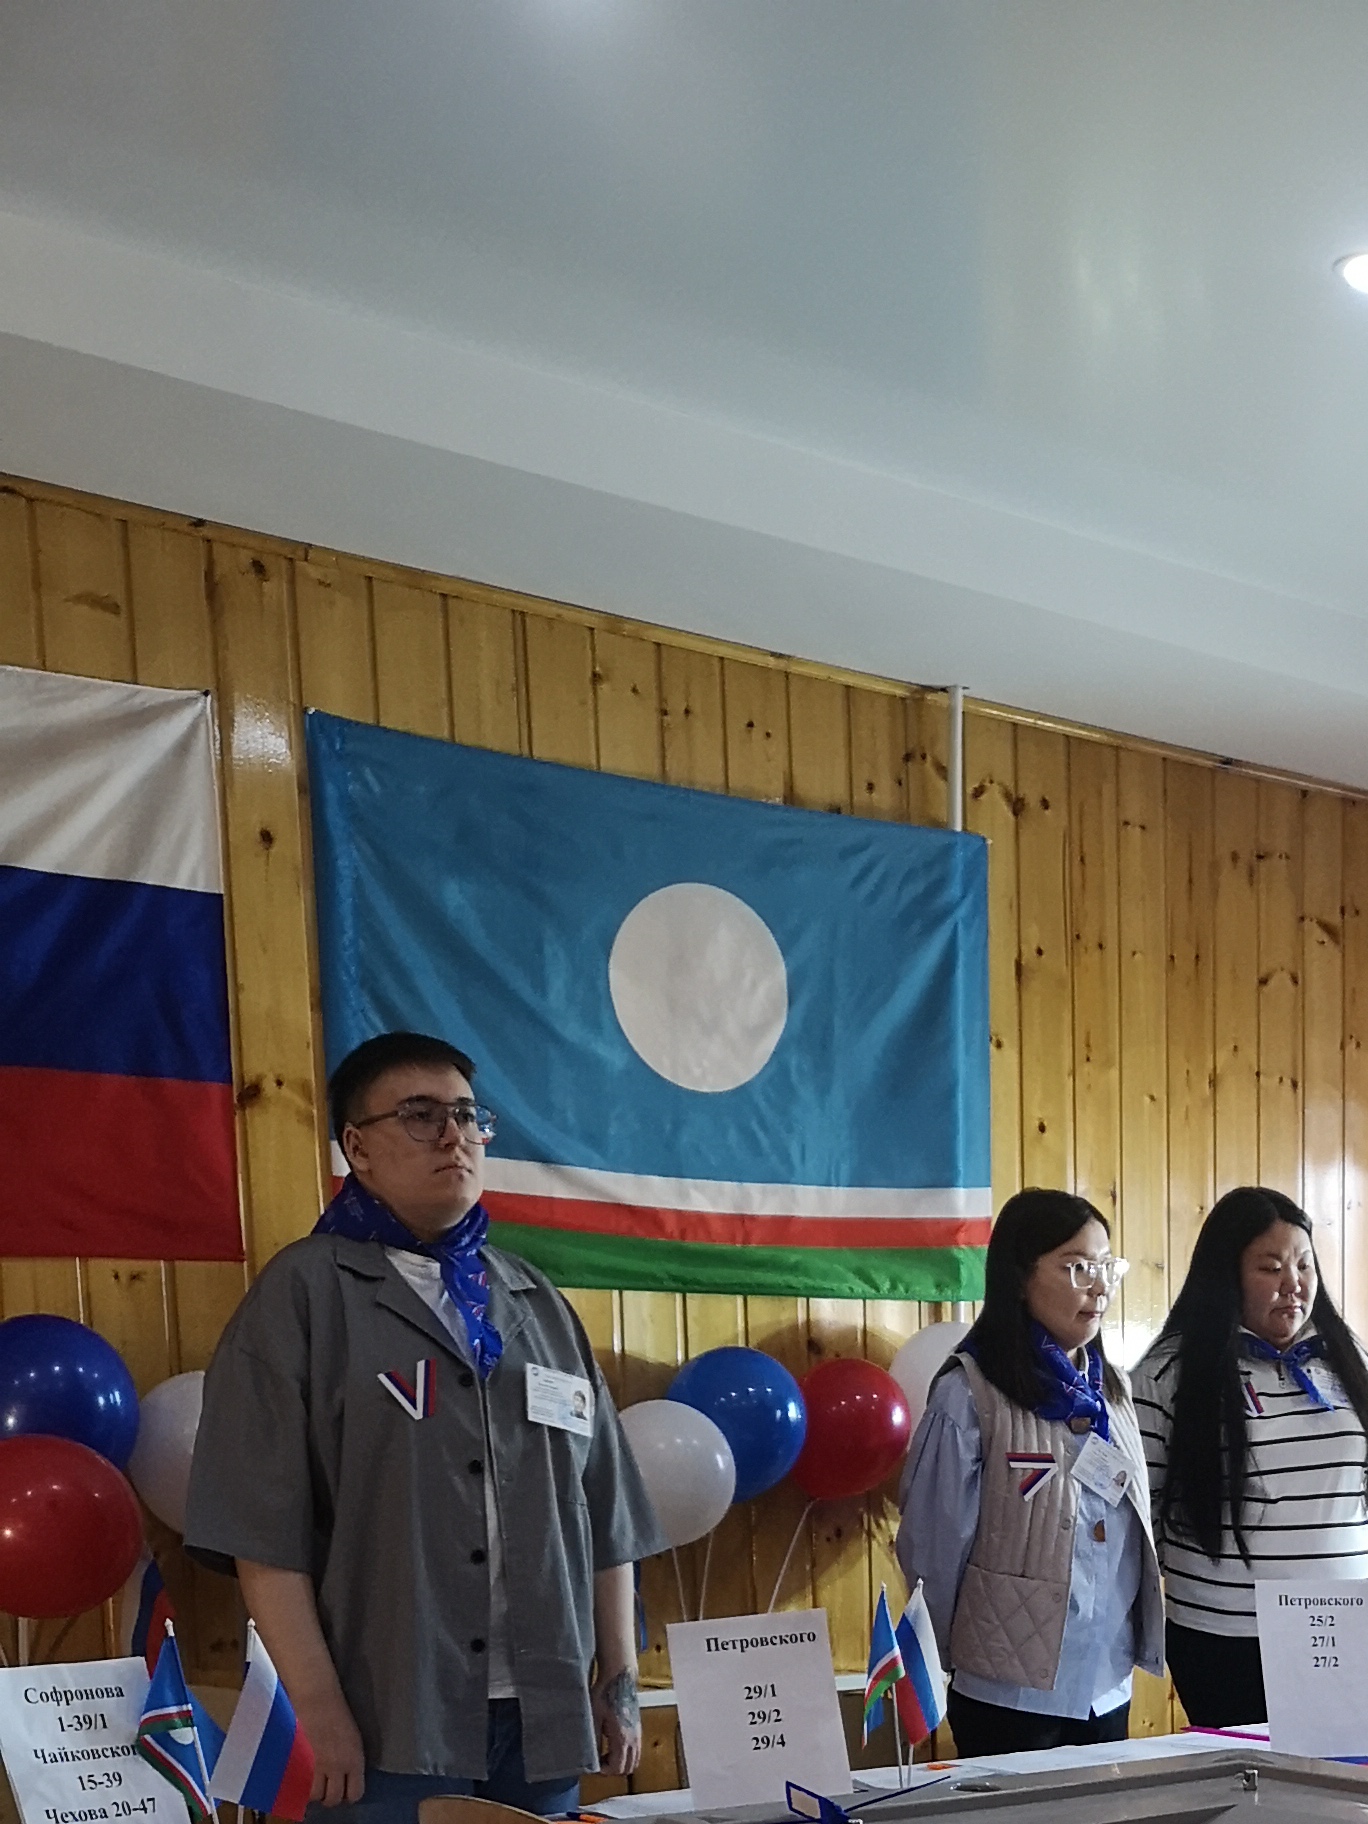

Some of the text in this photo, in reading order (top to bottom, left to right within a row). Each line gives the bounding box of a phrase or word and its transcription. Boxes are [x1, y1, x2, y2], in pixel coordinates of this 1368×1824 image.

[1278, 1594, 1364, 1609] Петровского
[1308, 1615, 1336, 1627] 25/2
[705, 1631, 817, 1653] Петровского
[1311, 1636, 1336, 1648] 27/1
[1313, 1656, 1340, 1668] 27/2
[24, 1686, 125, 1707] Софронова
[743, 1683, 778, 1700] 29/1
[57, 1713, 109, 1734] 1-39/1
[747, 1708, 783, 1726] 29/2
[751, 1733, 786, 1751] 29/4
[77, 1771, 123, 1792] 15-39
[44, 1797, 158, 1824] Чехова 20-47
